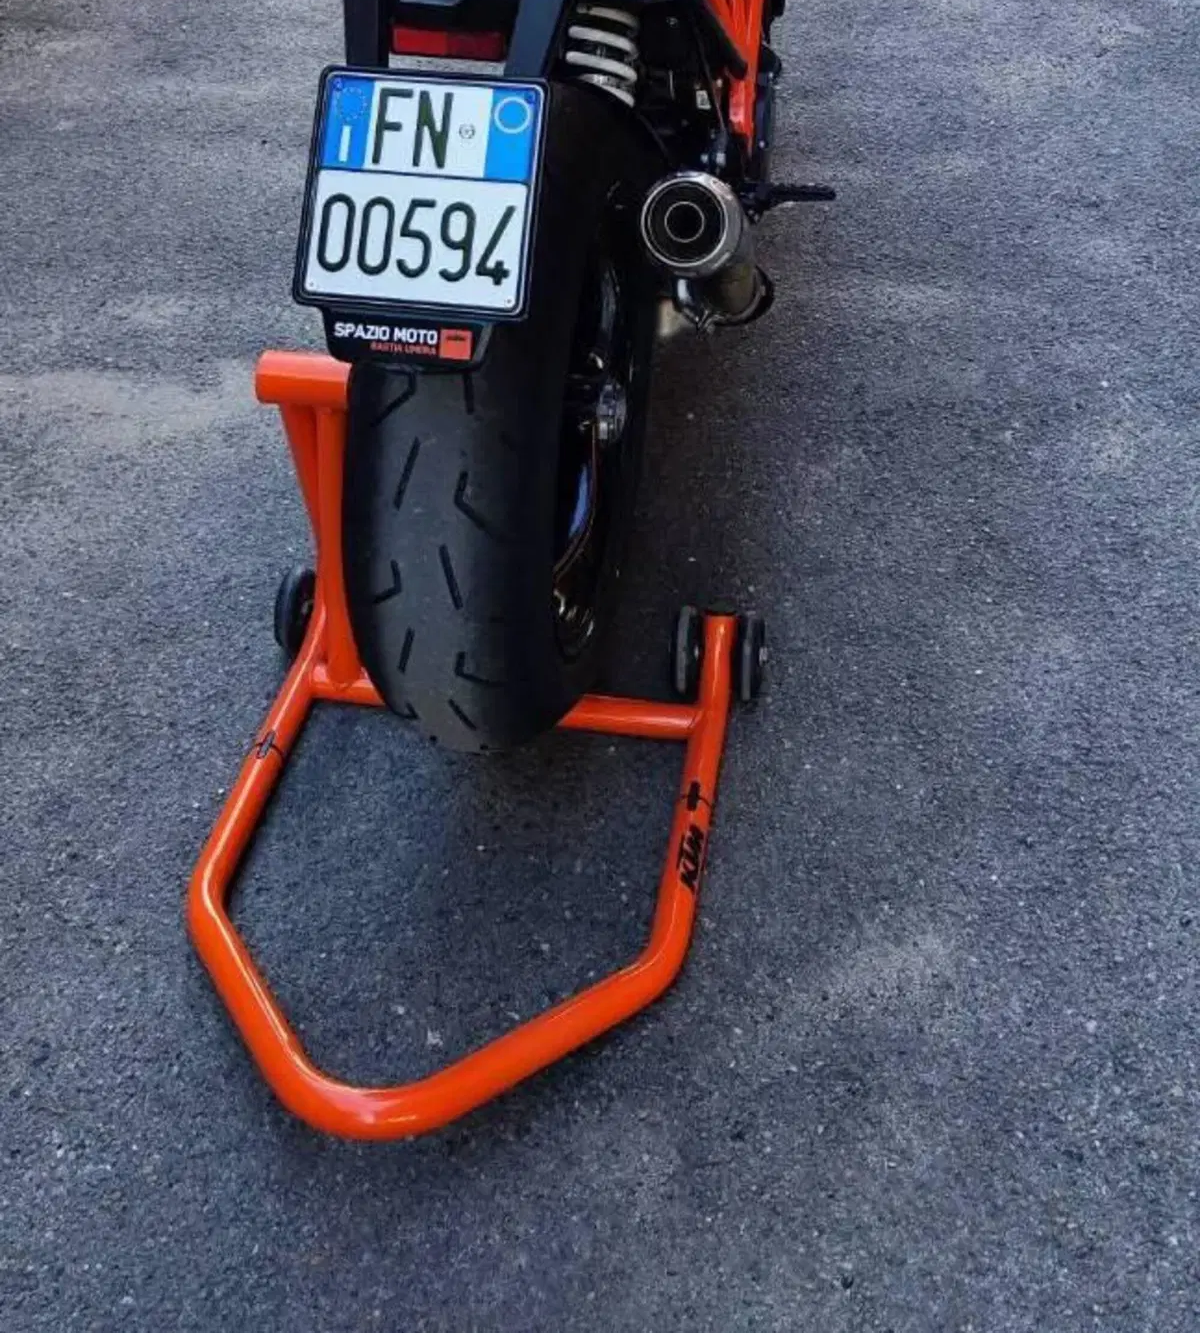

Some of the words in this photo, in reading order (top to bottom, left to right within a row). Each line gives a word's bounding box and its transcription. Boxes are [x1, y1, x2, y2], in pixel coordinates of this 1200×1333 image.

[372, 87, 454, 169] FN
[316, 193, 516, 286] 00594
[334, 322, 390, 341] SPAZIO
[393, 327, 438, 345] MOTO
[676, 824, 704, 894] KTM
